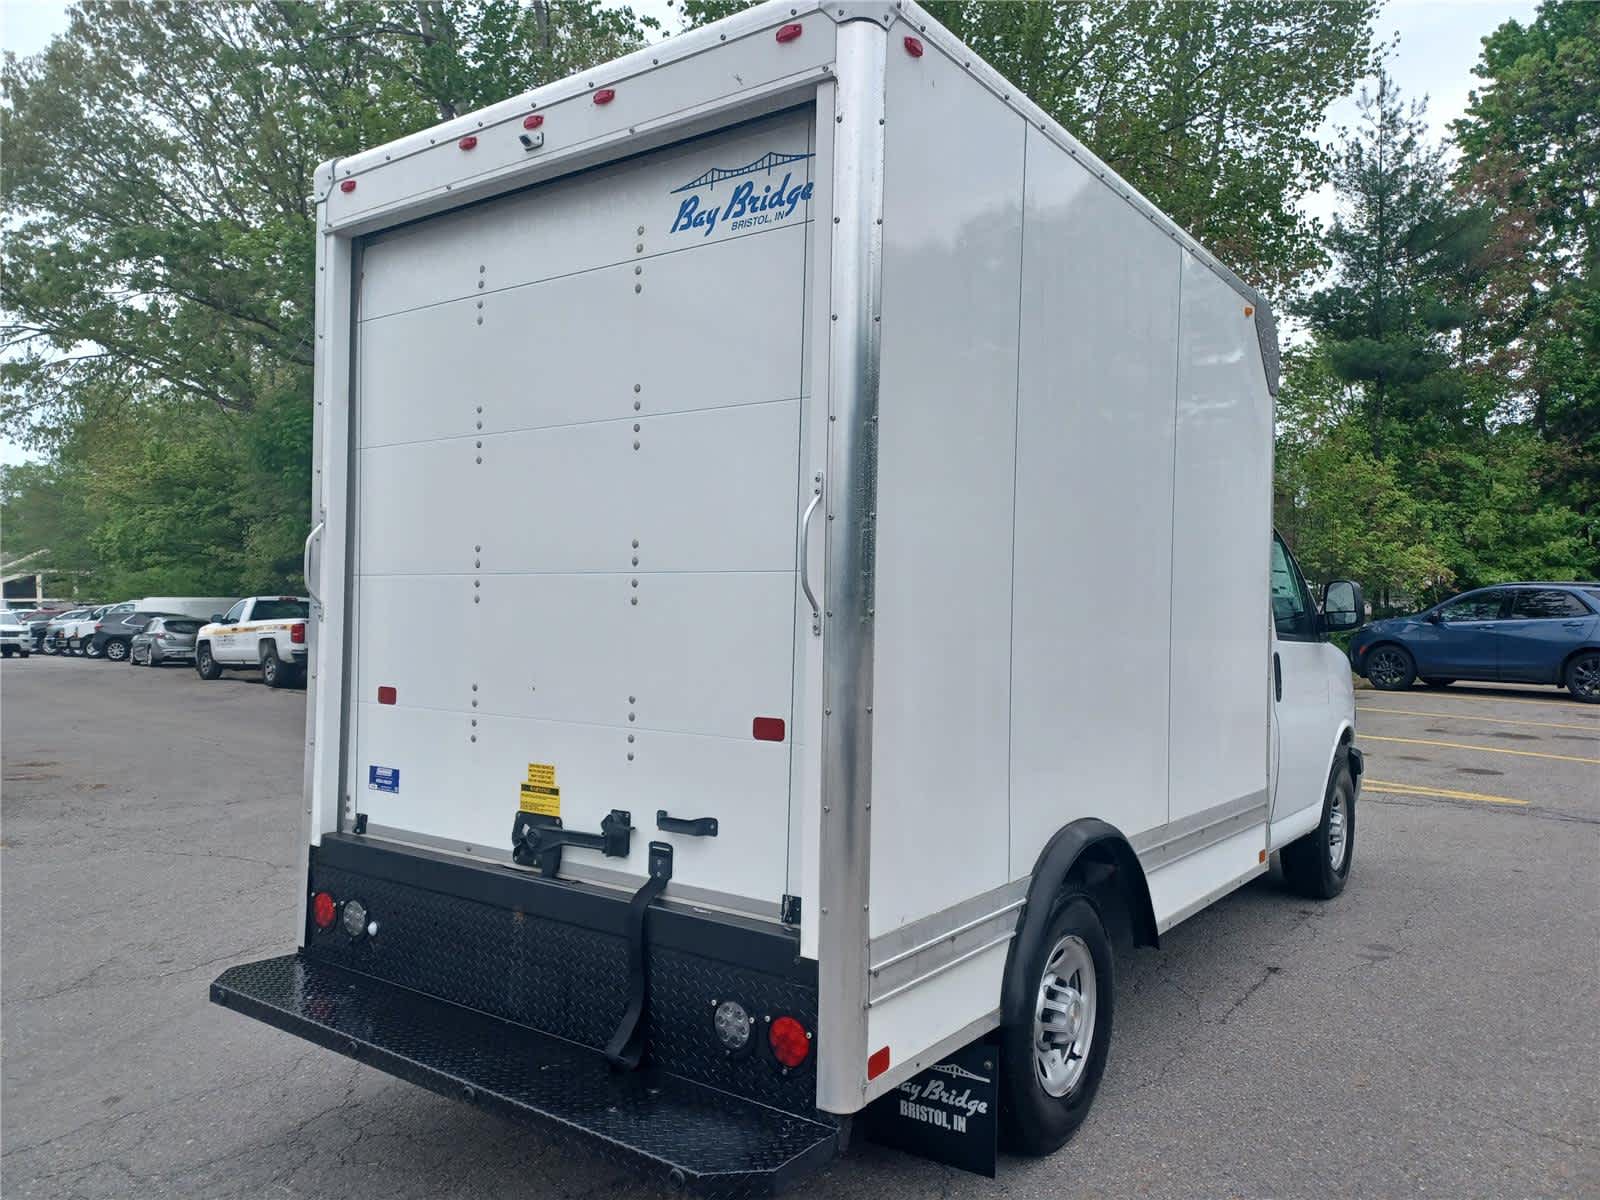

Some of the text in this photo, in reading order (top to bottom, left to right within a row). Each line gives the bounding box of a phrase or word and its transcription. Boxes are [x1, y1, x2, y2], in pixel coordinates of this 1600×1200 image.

[670, 172, 814, 237] Bay Bridge
[731, 210, 785, 231] BRISTOL, IN
[896, 1080, 988, 1117] ay Bridge
[900, 1099, 967, 1133] BRISTOL, IN
